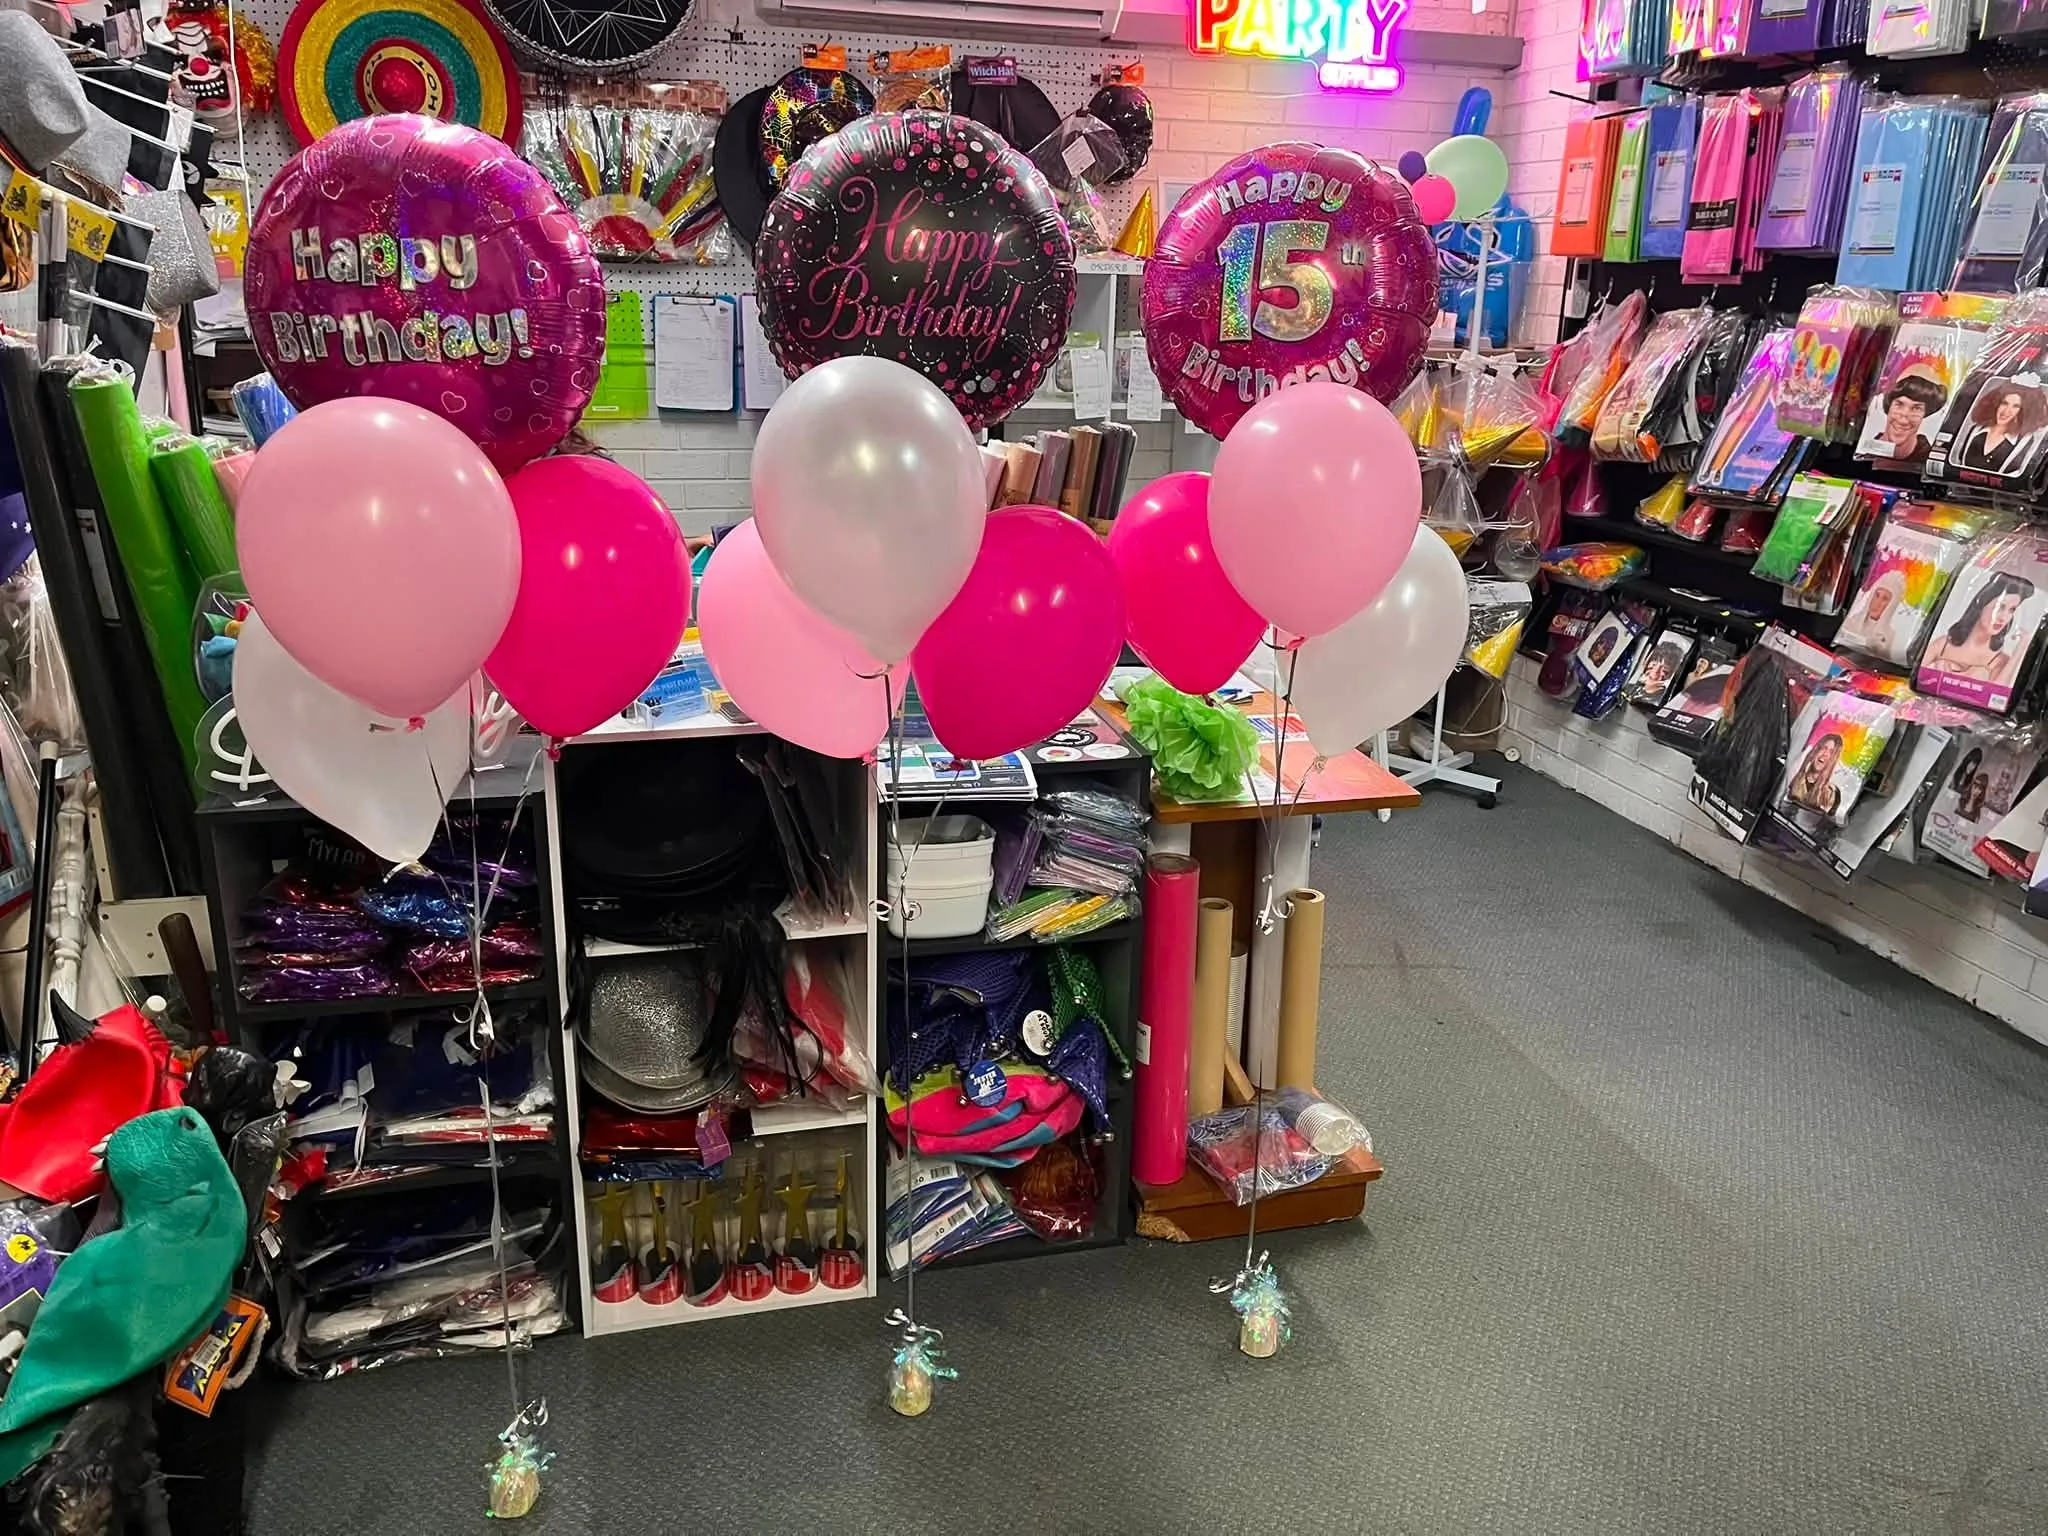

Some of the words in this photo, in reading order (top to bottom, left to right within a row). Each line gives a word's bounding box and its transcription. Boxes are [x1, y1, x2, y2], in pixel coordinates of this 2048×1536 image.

[1198, 0, 1405, 63] PARTY
[412, 58, 438, 111] HOT
[970, 65, 997, 77] Witch
[997, 66, 1015, 77] Hat
[1215, 171, 1352, 215] Happy
[291, 226, 479, 291] Happy
[825, 176, 1021, 296] Happy
[269, 308, 535, 366] Birthday!
[801, 263, 1023, 363] Birthday!
